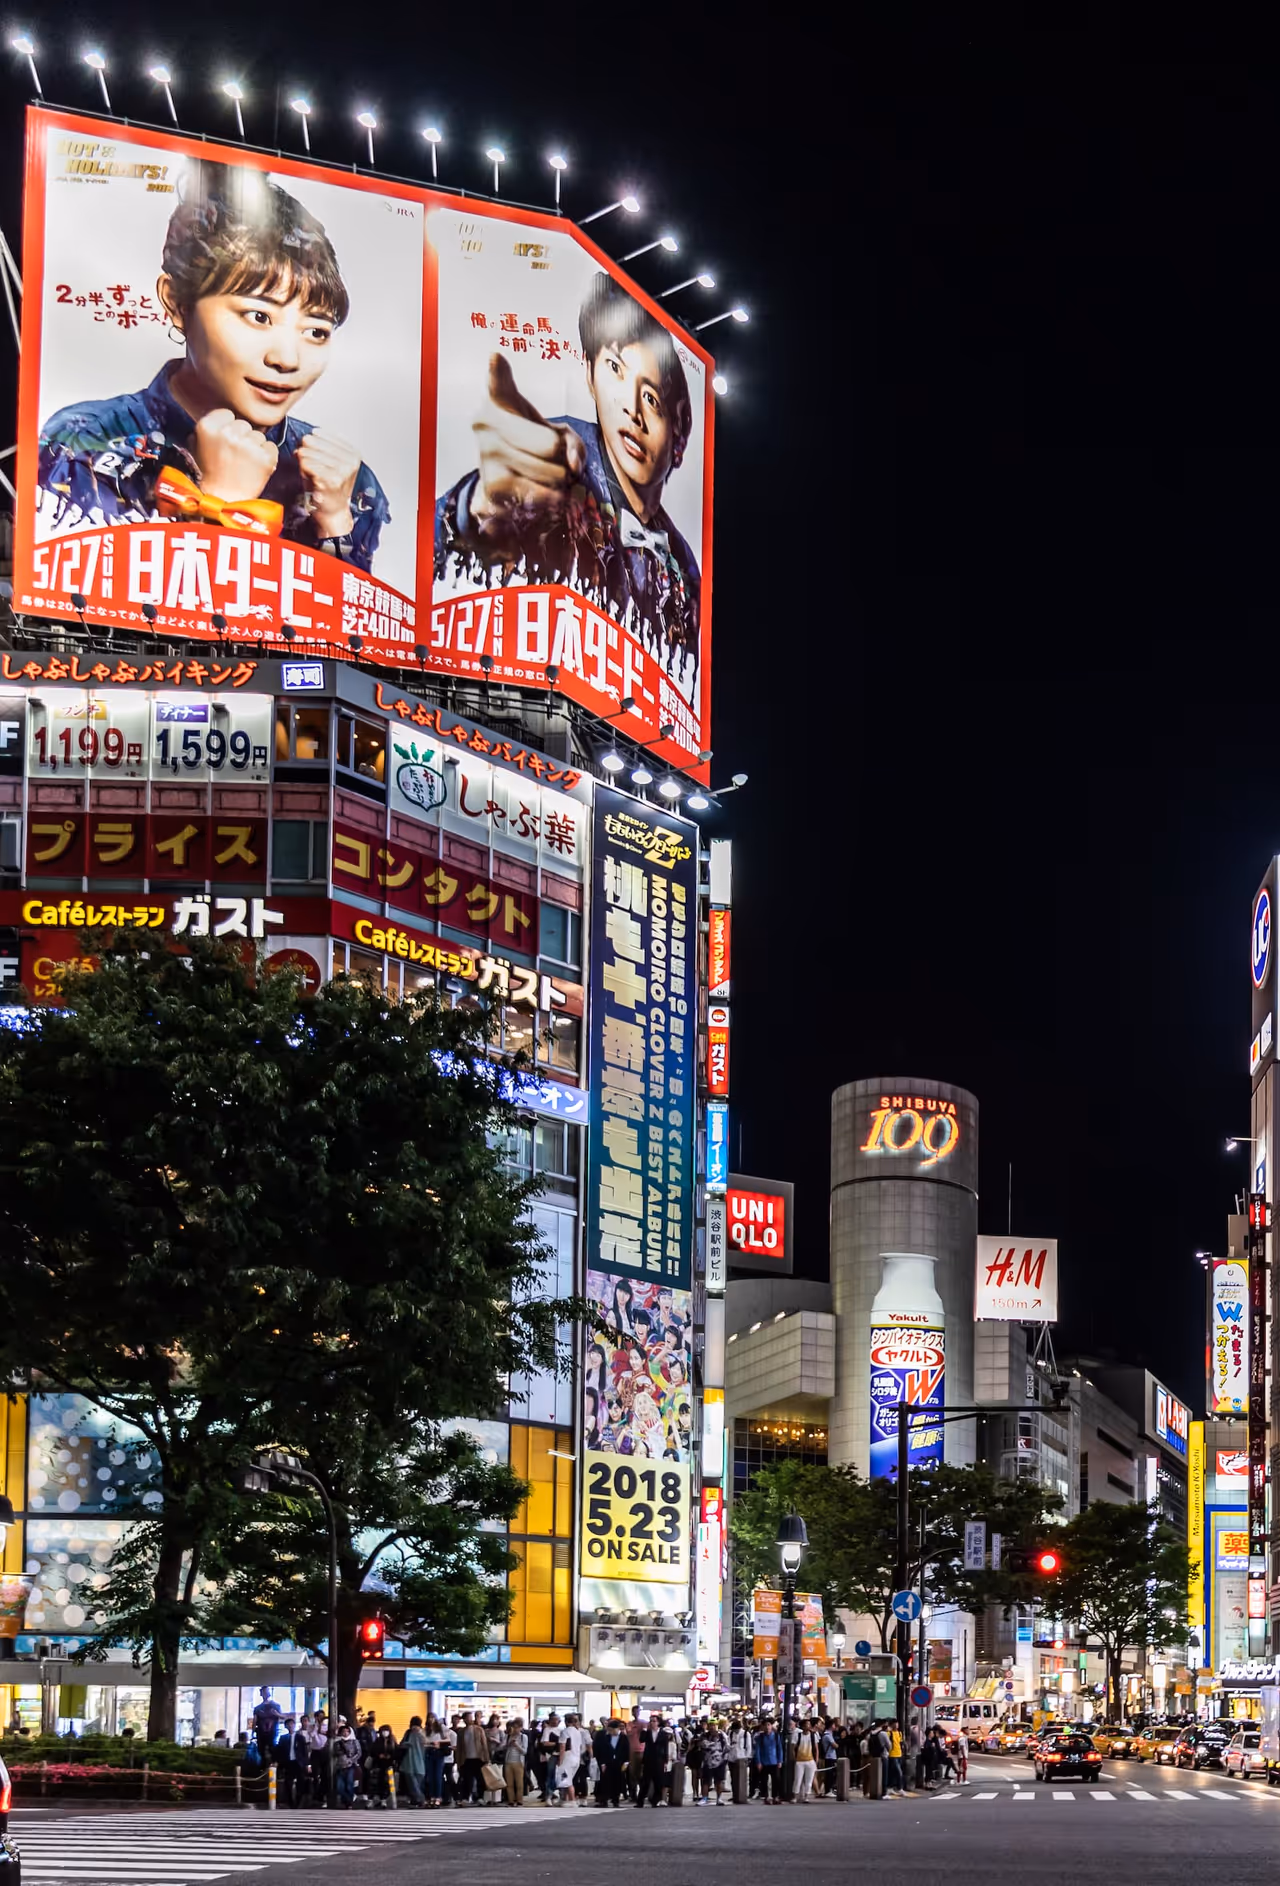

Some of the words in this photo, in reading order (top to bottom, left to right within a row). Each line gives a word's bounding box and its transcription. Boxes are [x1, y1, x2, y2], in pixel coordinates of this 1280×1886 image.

[396, 207, 416, 219] JRA
[32, 534, 101, 597] 5/27
[127, 530, 335, 630] 日本ダービー
[342, 570, 416, 628] 東京競馬場
[430, 595, 492, 655] 5/27
[1, 653, 258, 689] しゃぶしゃぶバイキング
[516, 592, 656, 720] 日本ダービー
[34, 725, 143, 771] 1,199円
[156, 728, 268, 776] 1,599円
[376, 682, 583, 791] しゃぶしゃぶバイキング
[459, 773, 577, 856] しゃぶ葉
[31, 819, 259, 866] プライス
[334, 832, 532, 934] コンタクト
[171, 895, 285, 938] ガスト
[650, 874, 668, 1003] MOMOIRO
[478, 955, 567, 1012] ガスト
[649, 1007, 666, 1100] CLOVER
[711, 1043, 726, 1086] ガスト
[649, 1105, 664, 1121] Z
[880, 1096, 957, 1115] SHIBUYA
[648, 1123, 664, 1184] BEST
[860, 1108, 960, 1166] 109
[646, 1183, 663, 1273] ALBUM
[731, 1196, 775, 1225] UNI
[710, 1208, 723, 1282] 渋谷駅前ビル
[731, 1221, 779, 1250] QLO
[985, 1247, 1048, 1290] H&M
[888, 1313, 929, 1323] Yakult
[885, 1350, 933, 1364] ヤクルト
[907, 1366, 945, 1406] W
[588, 1461, 683, 1506] 2018
[586, 1498, 682, 1543] 5.23
[587, 1536, 623, 1562] ON
[627, 1541, 681, 1566] SALE
